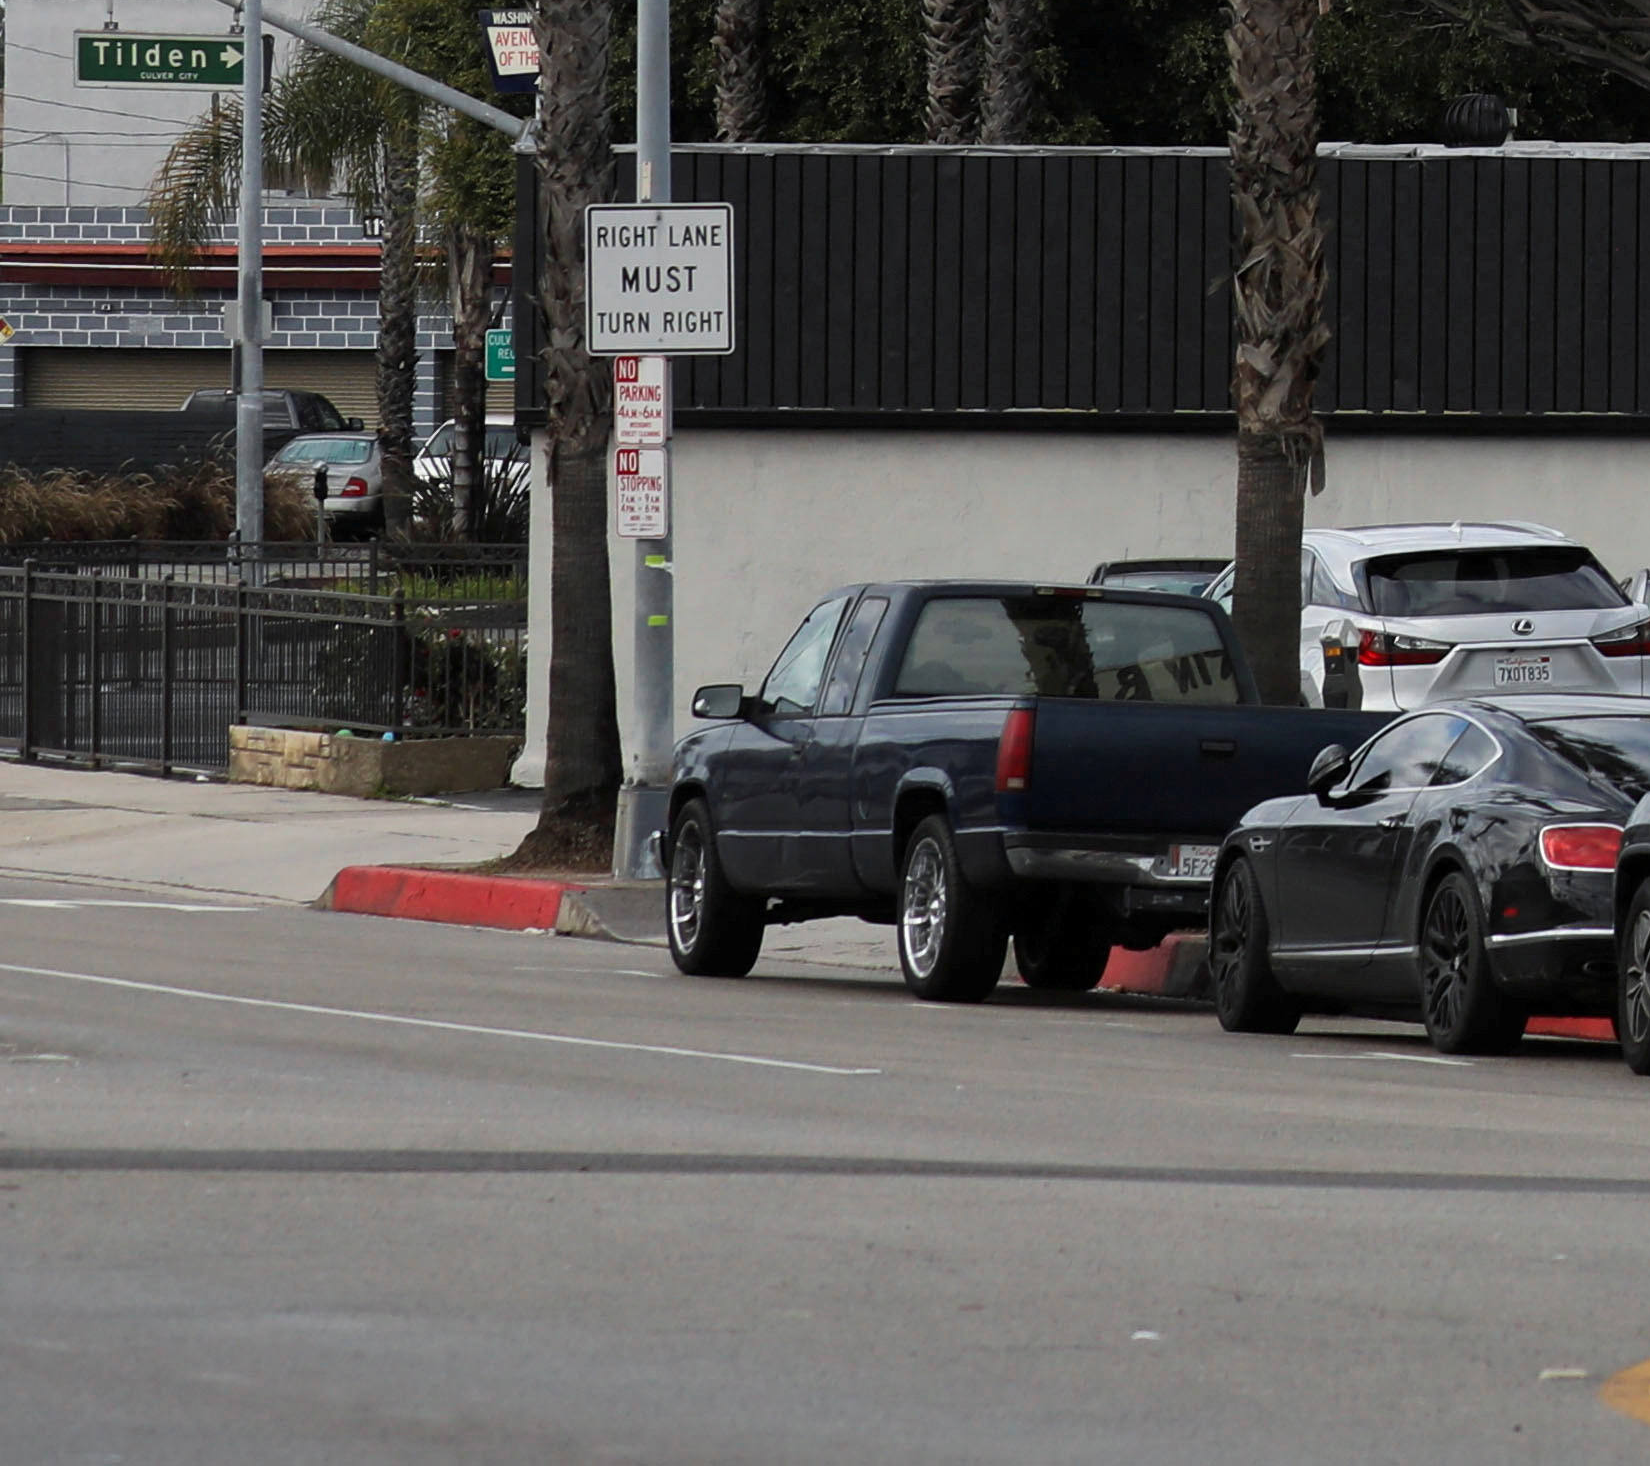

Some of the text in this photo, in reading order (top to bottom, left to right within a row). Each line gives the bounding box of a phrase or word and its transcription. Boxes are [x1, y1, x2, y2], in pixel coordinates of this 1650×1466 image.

[492, 12, 532, 24] WASHIN
[495, 31, 537, 46] AVENU
[93, 42, 206, 68] Tilden
[140, 71, 199, 80] CULVER CITY
[597, 225, 722, 247] RIGHT LANE
[621, 266, 697, 293] MUST
[597, 311, 723, 333] TURN RIGHT
[618, 360, 636, 379] NO
[619, 385, 661, 401] PARKING
[620, 452, 637, 472] NO
[620, 476, 662, 492] STOPPING
[1183, 858, 1216, 875] 5F29
